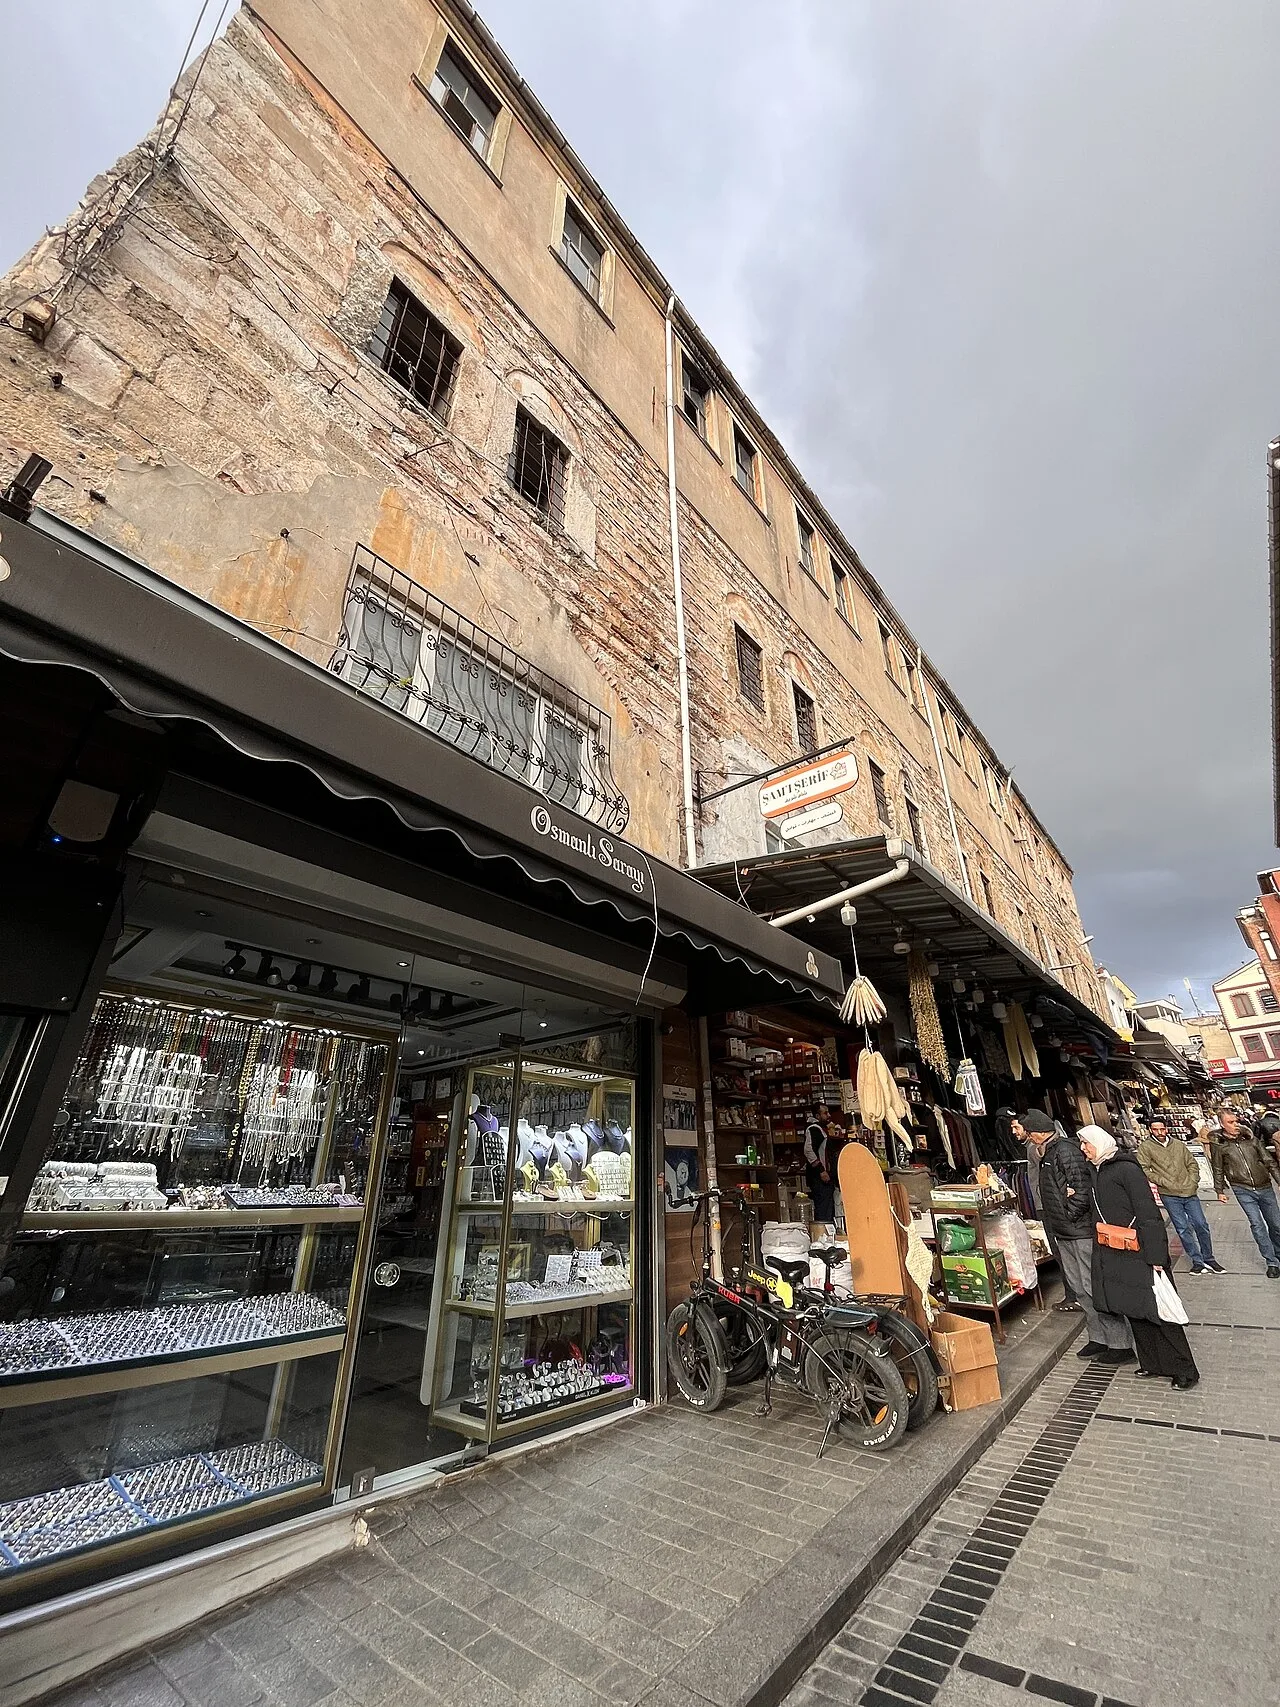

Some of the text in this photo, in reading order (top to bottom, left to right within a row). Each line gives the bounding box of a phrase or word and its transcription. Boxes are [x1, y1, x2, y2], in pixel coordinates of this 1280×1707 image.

[530, 805, 645, 893] Osmanlı Sarayı
[747, 1269, 766, 1285] Jeep
